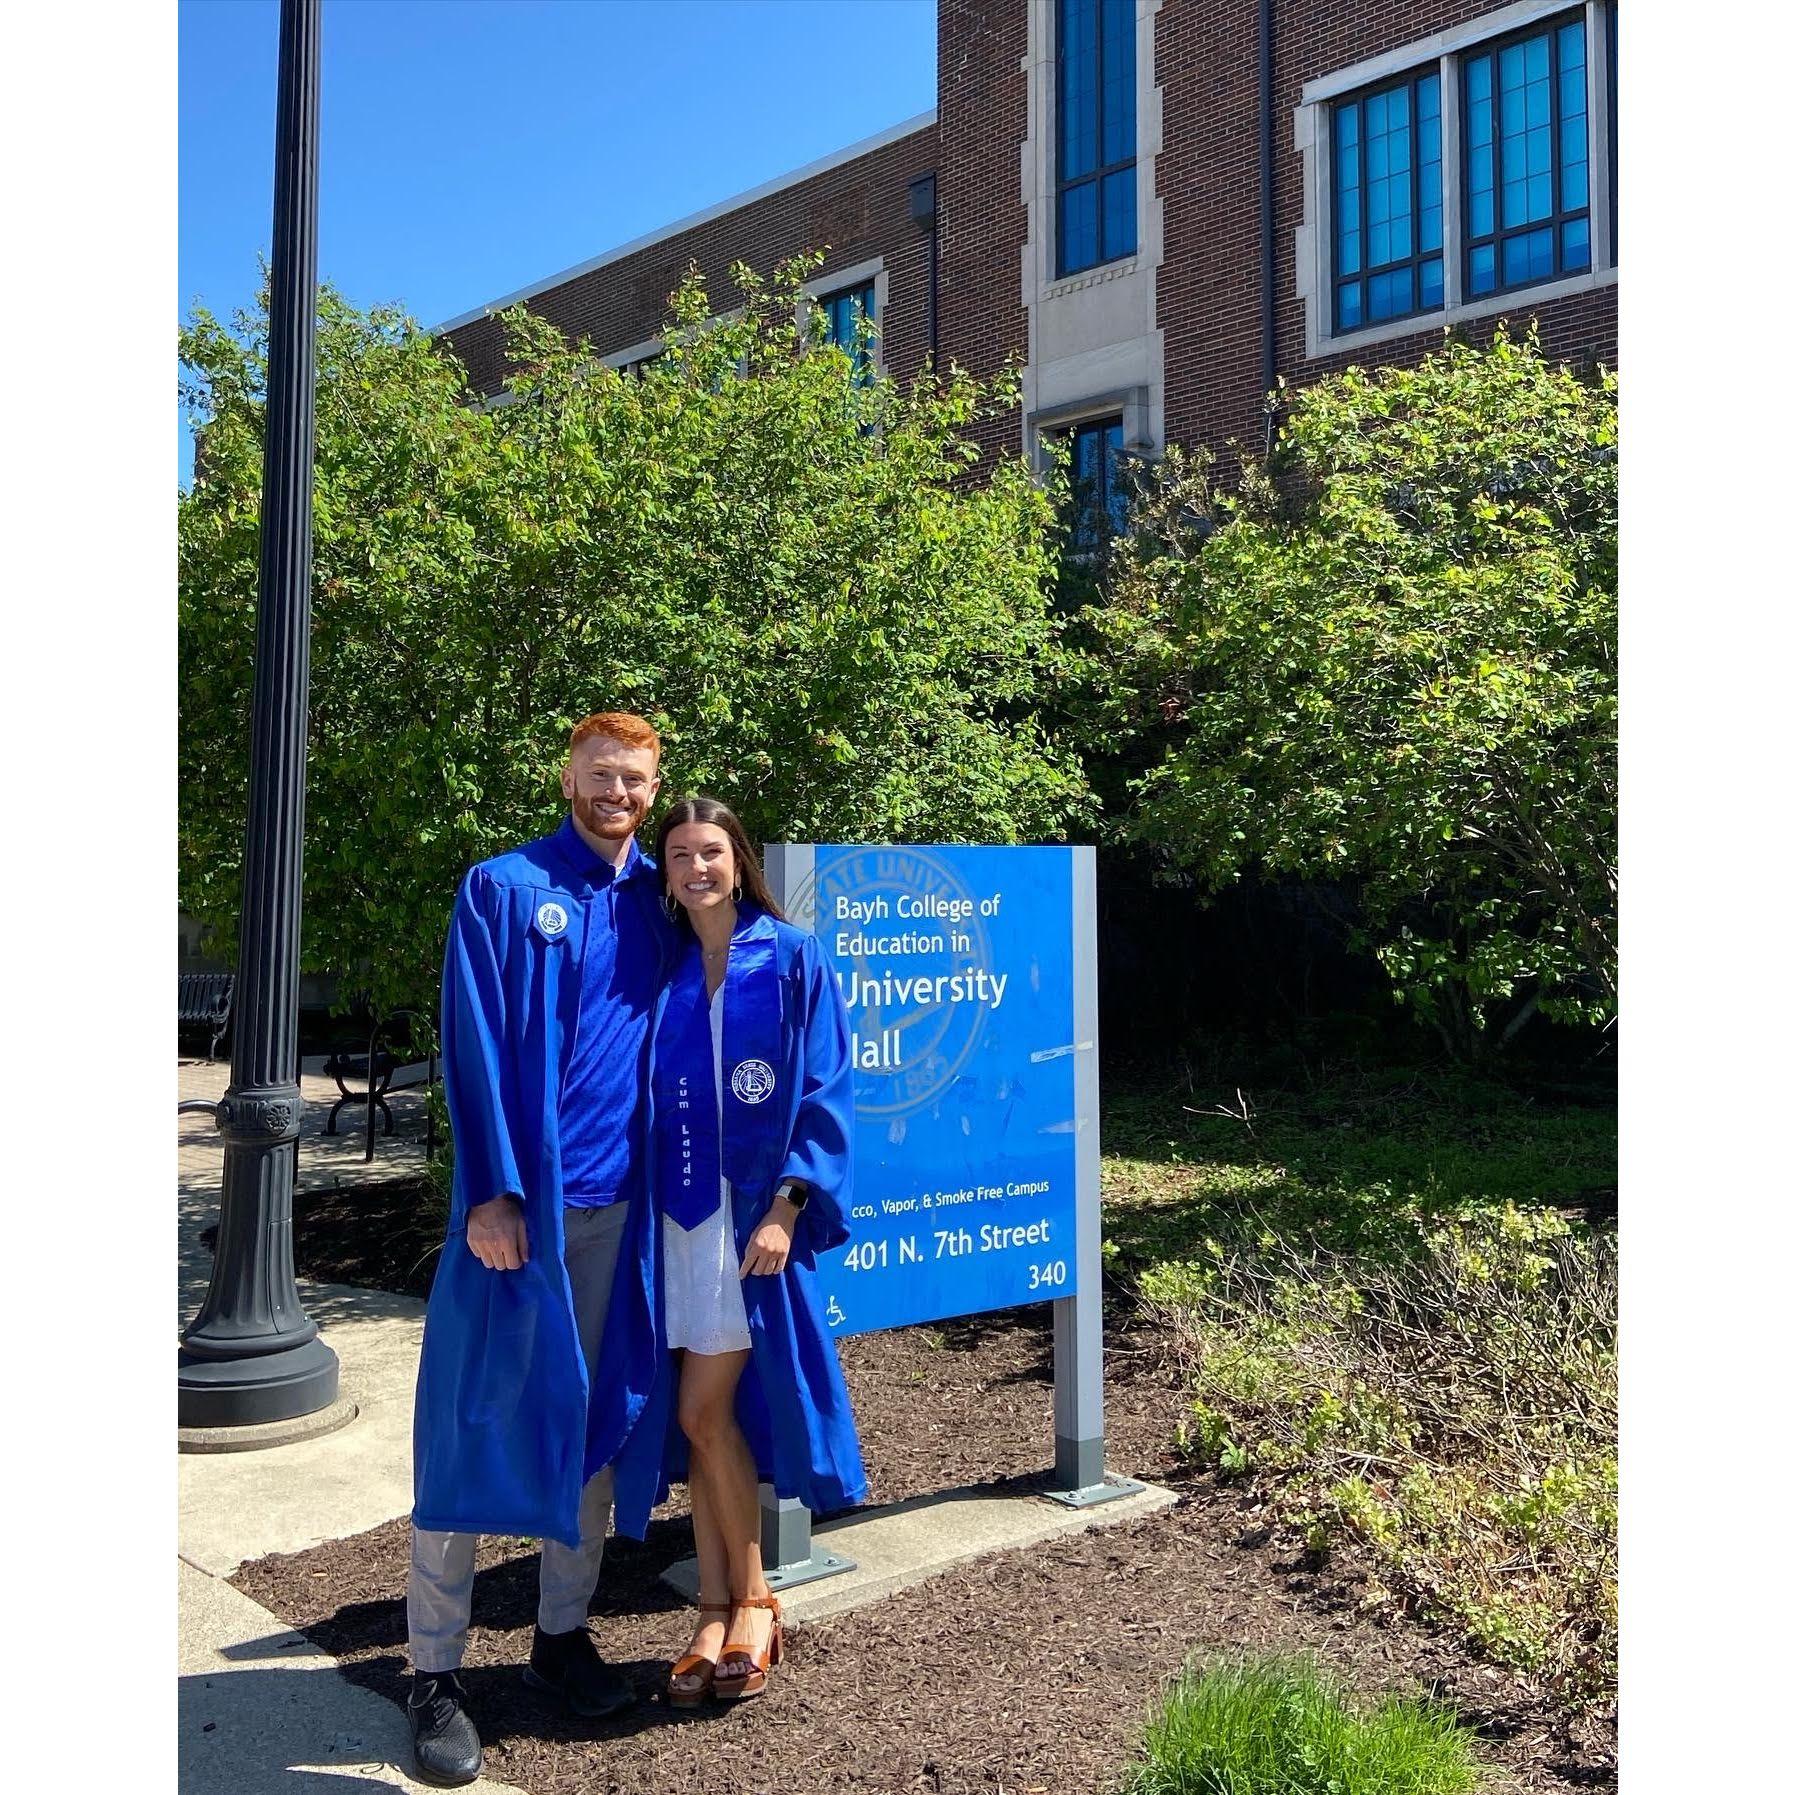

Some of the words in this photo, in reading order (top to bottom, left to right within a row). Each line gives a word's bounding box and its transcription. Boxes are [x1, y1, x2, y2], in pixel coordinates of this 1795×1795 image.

[836, 895, 889, 924] Bayh
[897, 894, 973, 923] College
[980, 893, 1001, 917] of
[836, 931, 943, 956] Education
[951, 930, 970, 952] in
[836, 968, 1008, 1009] University
[851, 1205, 877, 1219] cco,
[881, 1199, 919, 1216] Vapor,
[923, 1194, 932, 1208] &
[935, 1189, 975, 1207] Smoke
[977, 1186, 1004, 1201] Free
[1006, 1181, 1050, 1196] Campus
[844, 1240, 887, 1272] 401
[899, 1236, 924, 1264] N.
[934, 1228, 972, 1258] 7th
[980, 1218, 1050, 1252] Street
[1028, 1261, 1066, 1289] 340
